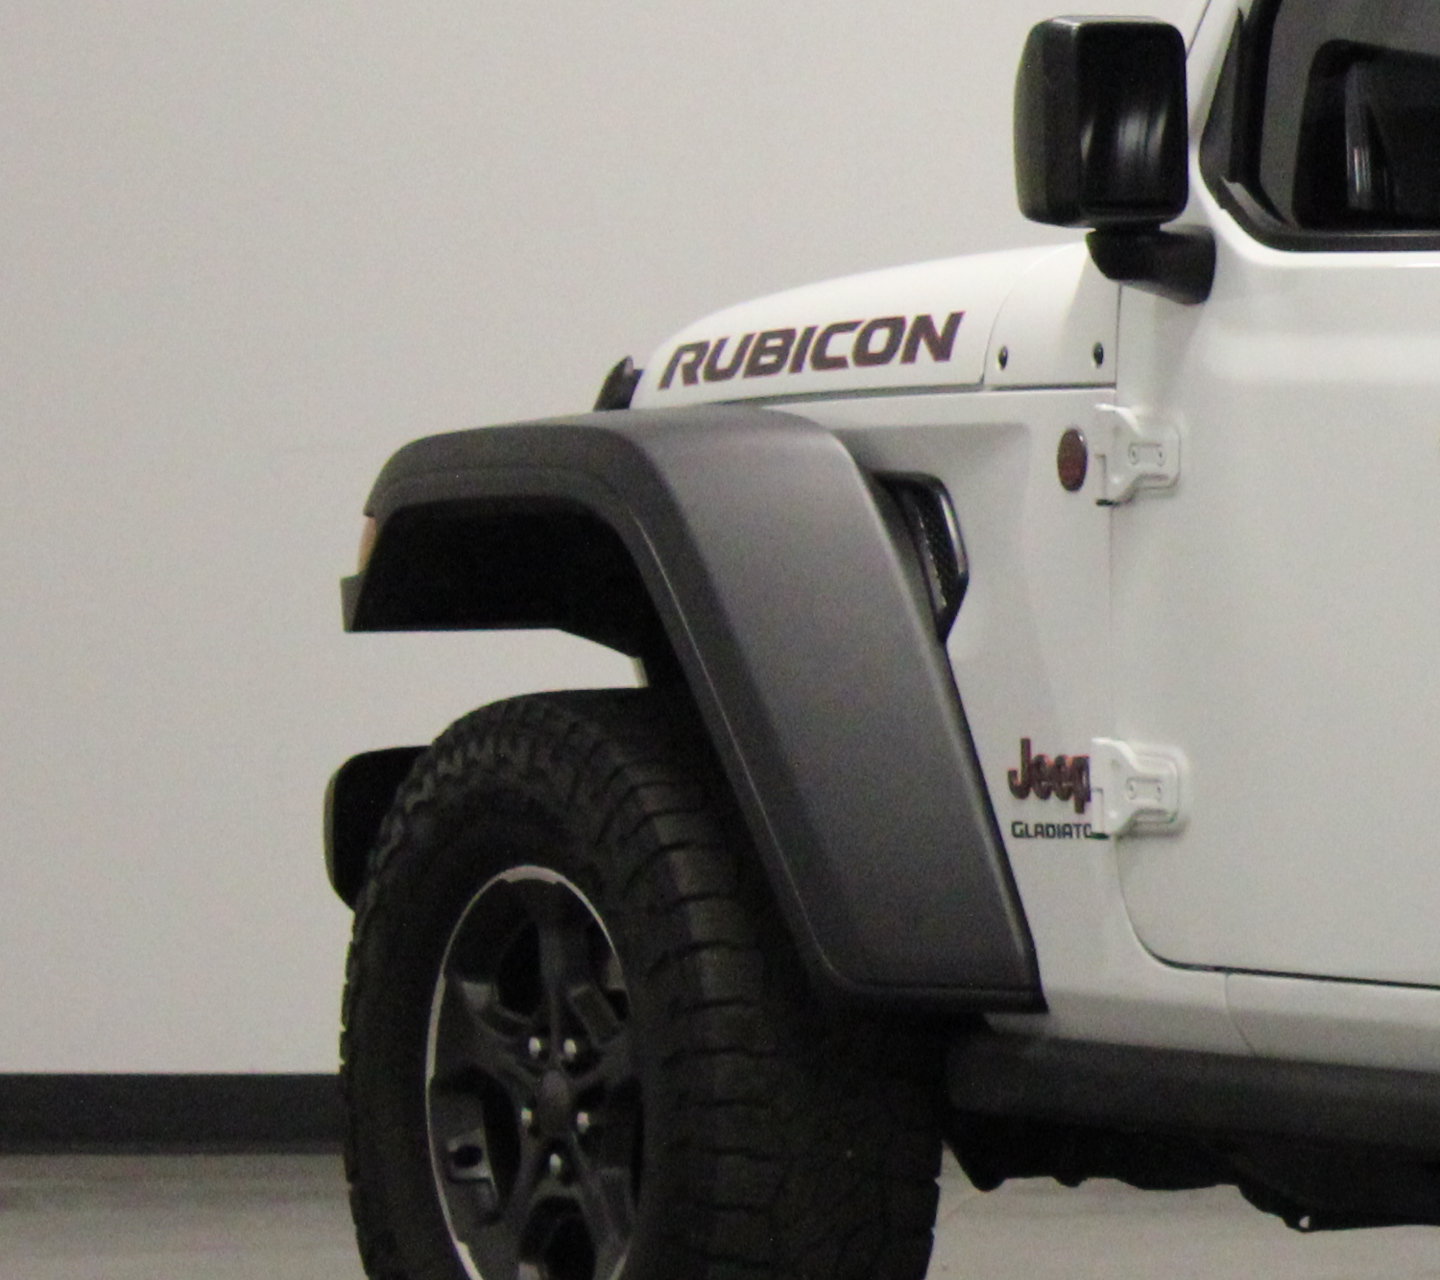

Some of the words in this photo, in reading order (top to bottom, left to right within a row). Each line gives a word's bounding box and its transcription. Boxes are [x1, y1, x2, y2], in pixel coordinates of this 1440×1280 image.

[658, 311, 965, 390] RUBICON
[1008, 737, 1091, 814] Jeep
[1011, 821, 1092, 839] GLADIATO
